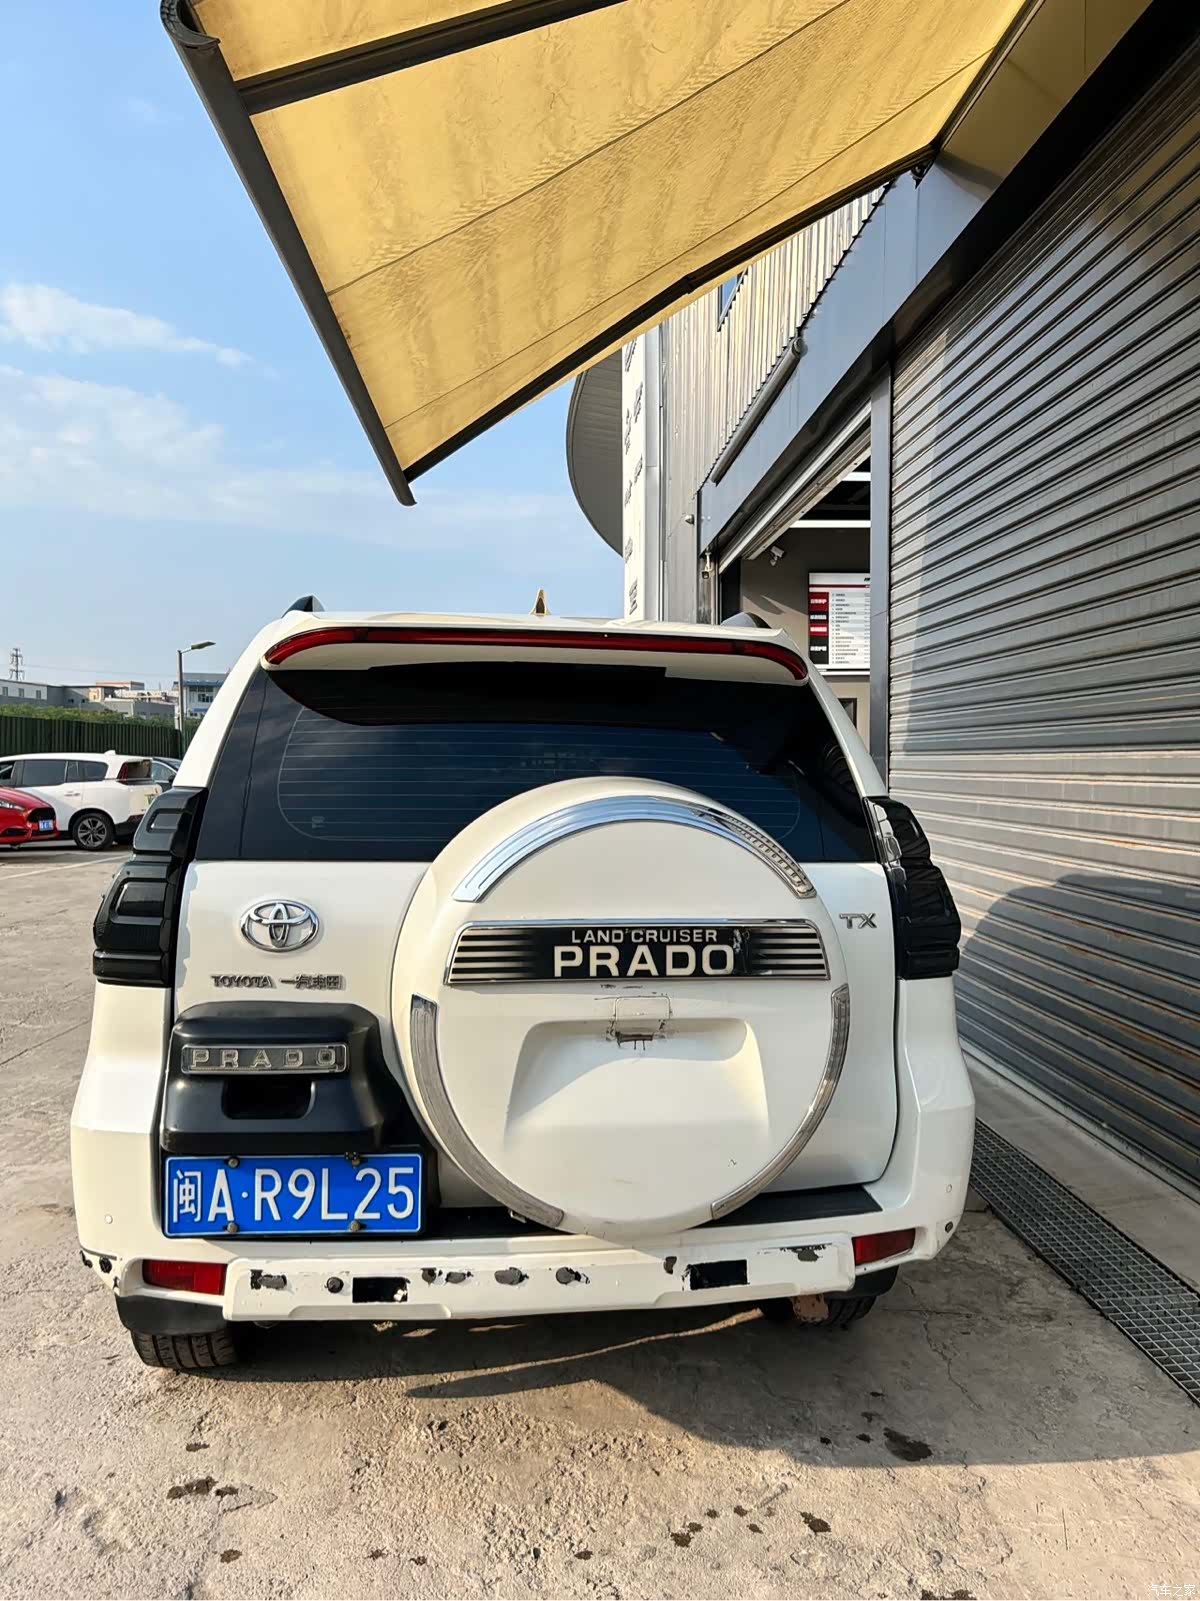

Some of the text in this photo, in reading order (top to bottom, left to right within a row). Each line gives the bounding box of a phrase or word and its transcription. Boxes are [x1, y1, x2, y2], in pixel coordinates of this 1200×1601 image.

[839, 912, 877, 930] TX
[571, 929, 718, 944] LAND CRUISER
[553, 944, 735, 977] PRADO
[211, 975, 275, 989] TOYOTA
[191, 1048, 337, 1069] PRADO
